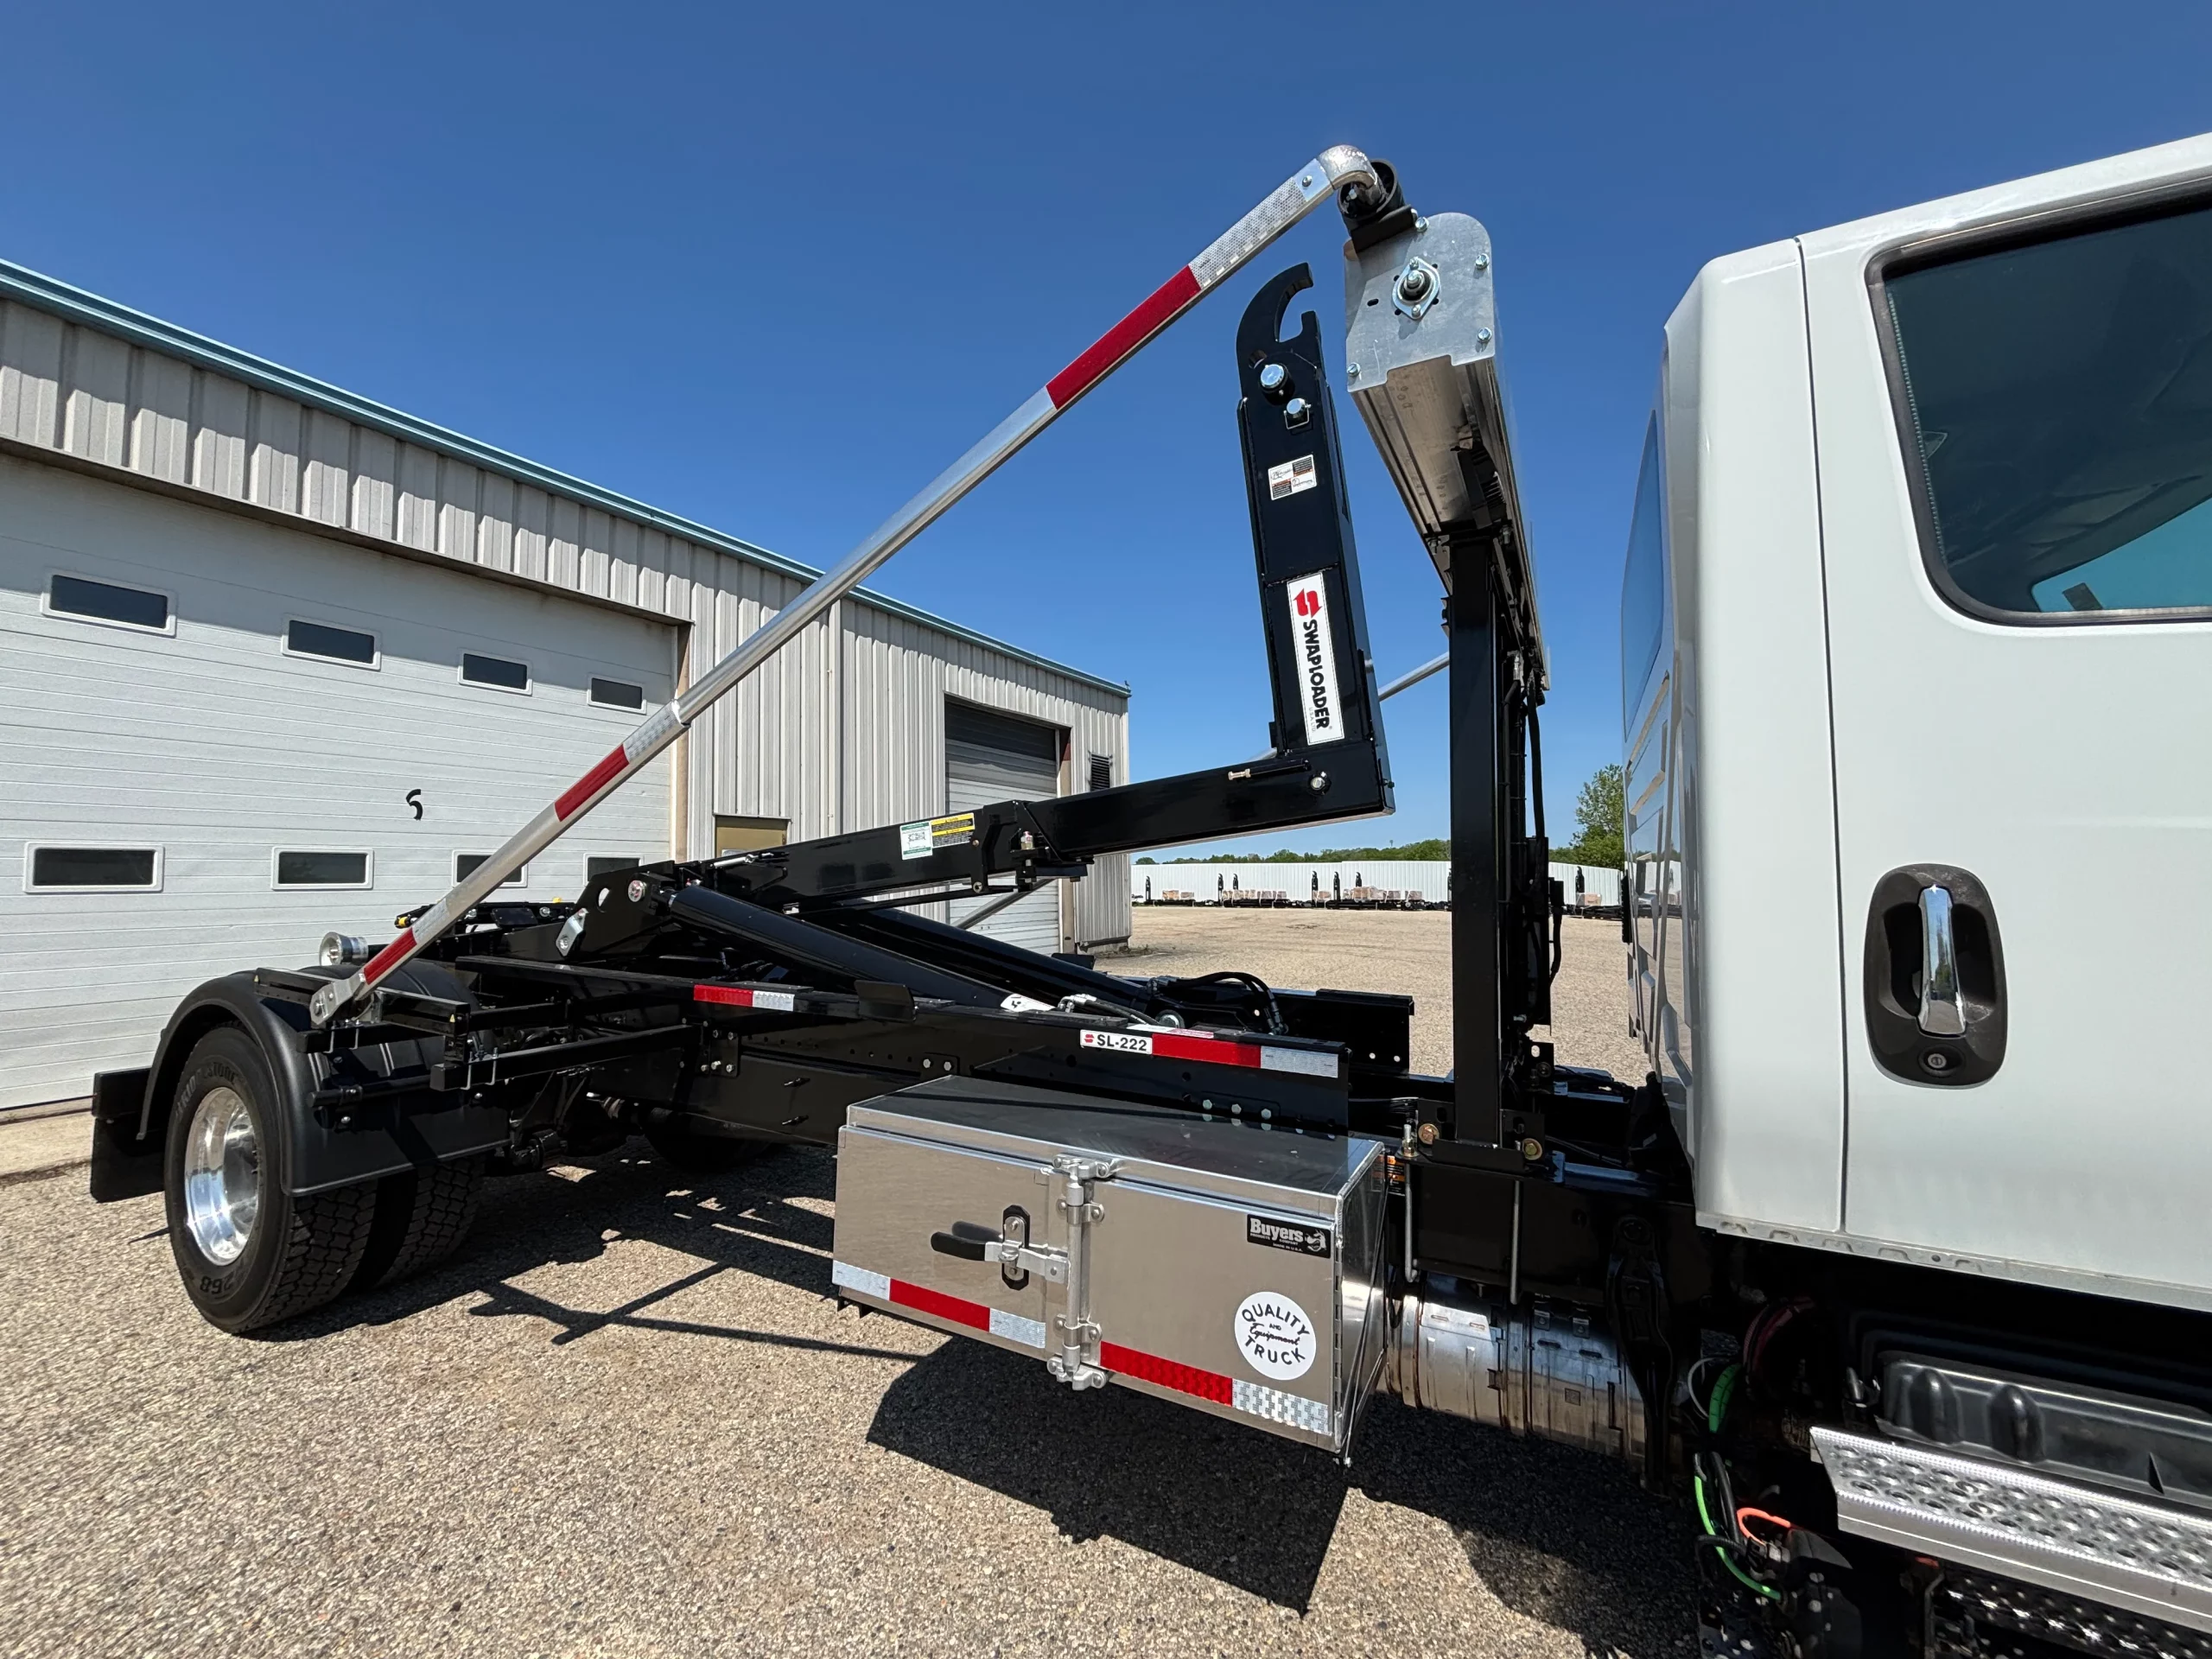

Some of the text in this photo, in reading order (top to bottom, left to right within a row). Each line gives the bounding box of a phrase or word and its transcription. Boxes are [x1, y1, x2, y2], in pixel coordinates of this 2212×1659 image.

[1096, 1034, 1147, 1052] SL-222
[1249, 1217, 1304, 1243] Buyers
[1242, 1303, 1310, 1336] QUALITY
[1249, 1323, 1300, 1345] Equipment
[1245, 1335, 1306, 1365] TRUCK
